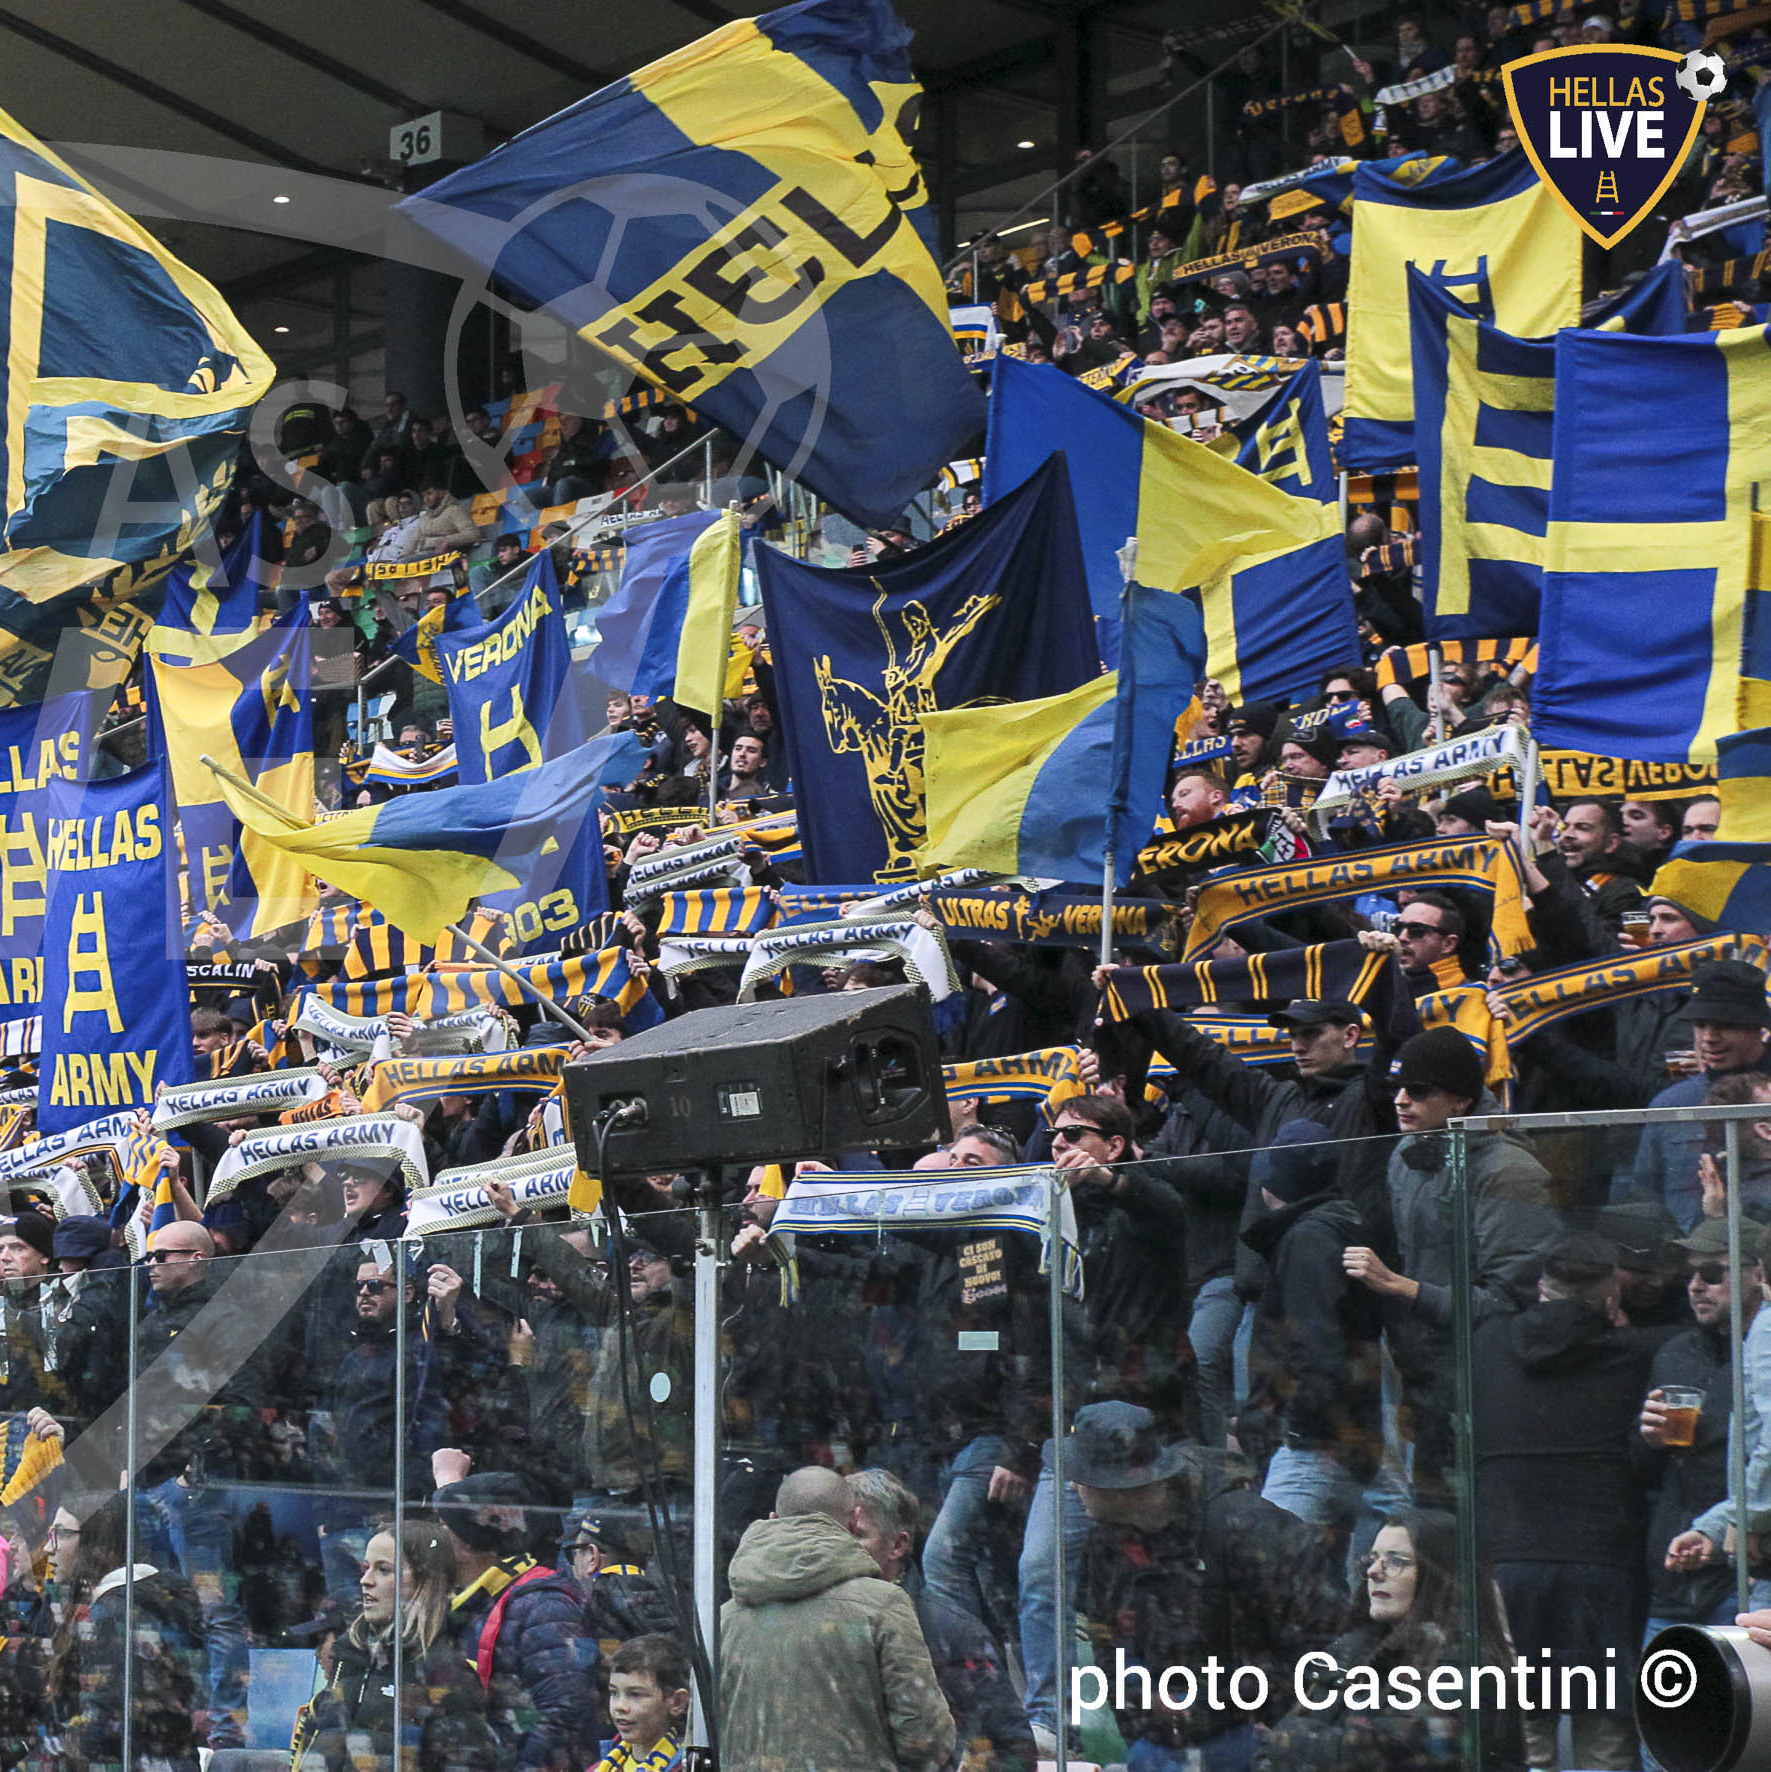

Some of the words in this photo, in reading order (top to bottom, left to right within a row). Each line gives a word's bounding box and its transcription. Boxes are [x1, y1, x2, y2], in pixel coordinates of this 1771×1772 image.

[400, 125, 428, 161] 36
[1183, 252, 1240, 275] HELLAS
[599, 187, 902, 392] HEL
[601, 512, 644, 527] HELAS
[444, 586, 553, 684] VERONA
[1434, 732, 1506, 769] ARMY
[47, 803, 163, 872] HELLAS
[1137, 821, 1258, 875] ERONA
[1234, 863, 1373, 905] HELLAS
[1390, 845, 1500, 875] ARMY
[937, 897, 1010, 930] ULTRAS
[1064, 904, 1148, 935] VERNA
[681, 941, 748, 959] HELLA
[761, 930, 834, 958] HELLAS
[844, 923, 915, 942] ARMY
[1509, 968, 1637, 1016] ELLAS
[1205, 1027, 1289, 1046] ELLA
[50, 1049, 158, 1108] ARMY
[383, 1060, 485, 1089] HELLAS
[497, 1053, 564, 1076] ARM
[166, 1089, 239, 1116] HELLAS
[247, 1078, 310, 1102] ARMY
[77, 1117, 131, 1142] ARM
[240, 1132, 318, 1166] HELLAS
[328, 1122, 396, 1147] ARMY
[526, 1167, 574, 1199] ARM
[959, 1248, 1002, 1268] CASCATO
[964, 1244, 974, 1256] CI
[976, 1239, 996, 1254] SON
[976, 1263, 987, 1275] DI
